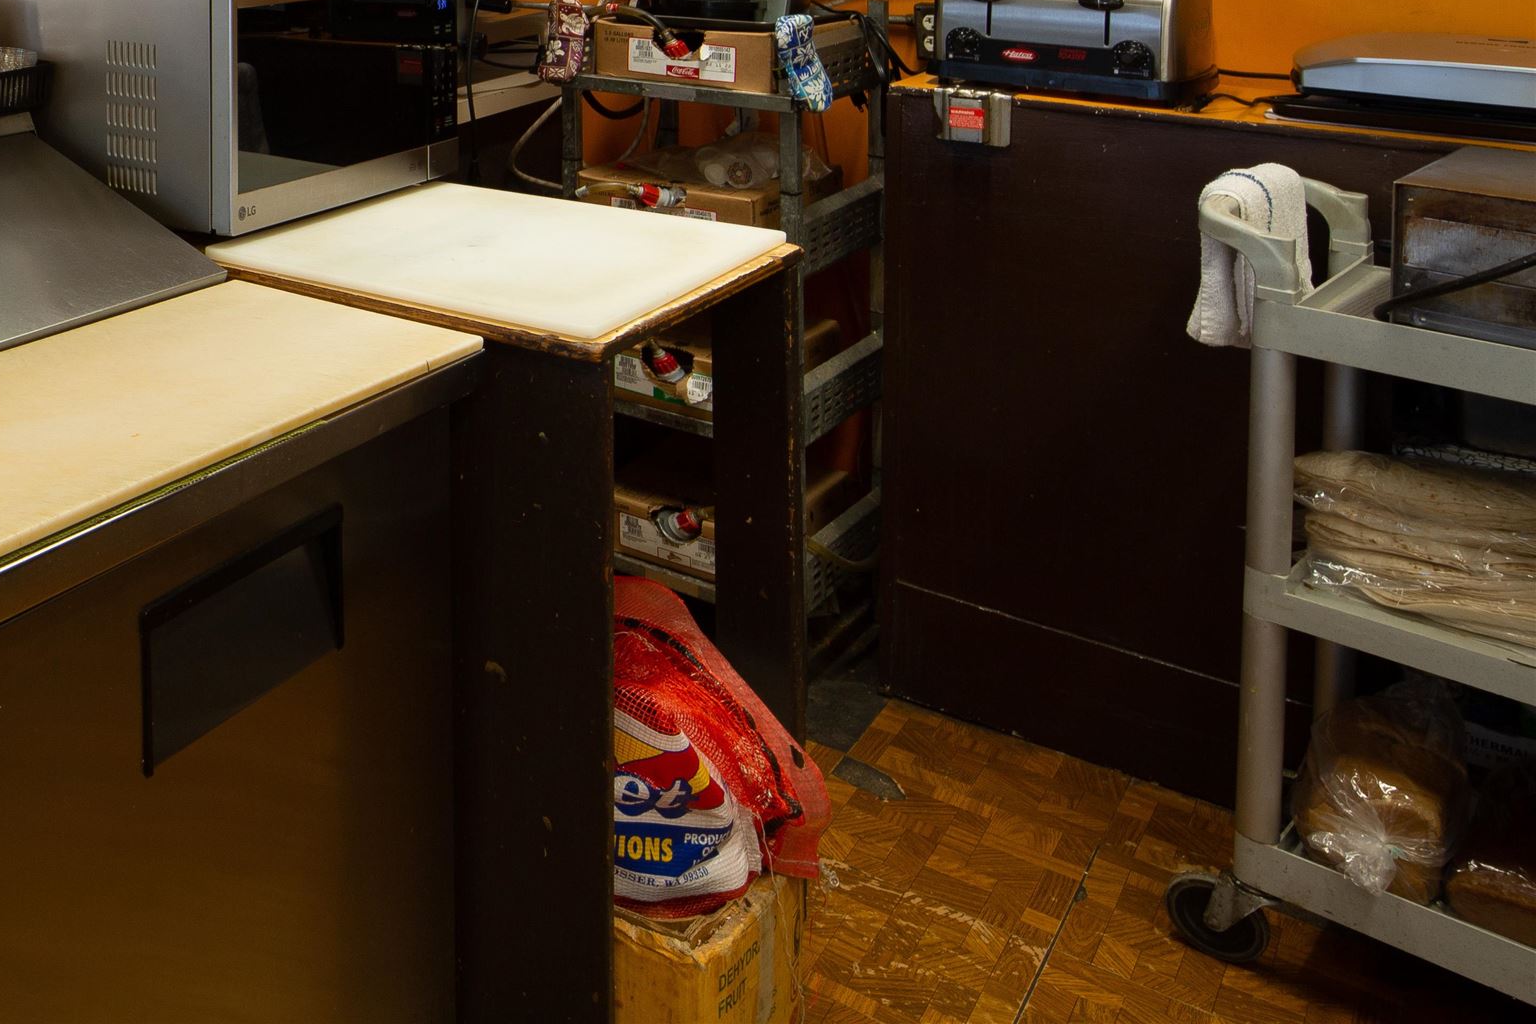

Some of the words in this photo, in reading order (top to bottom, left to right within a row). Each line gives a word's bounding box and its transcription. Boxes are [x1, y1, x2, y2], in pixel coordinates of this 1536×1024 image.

[671, 66, 695, 76] Coca-Cola
[247, 205, 256, 217] LG
[614, 775, 686, 809] et
[665, 878, 681, 888] WA
[683, 867, 709, 884] 99350
[718, 940, 760, 993] DEHYDR
[718, 977, 747, 1019] FRUIT
